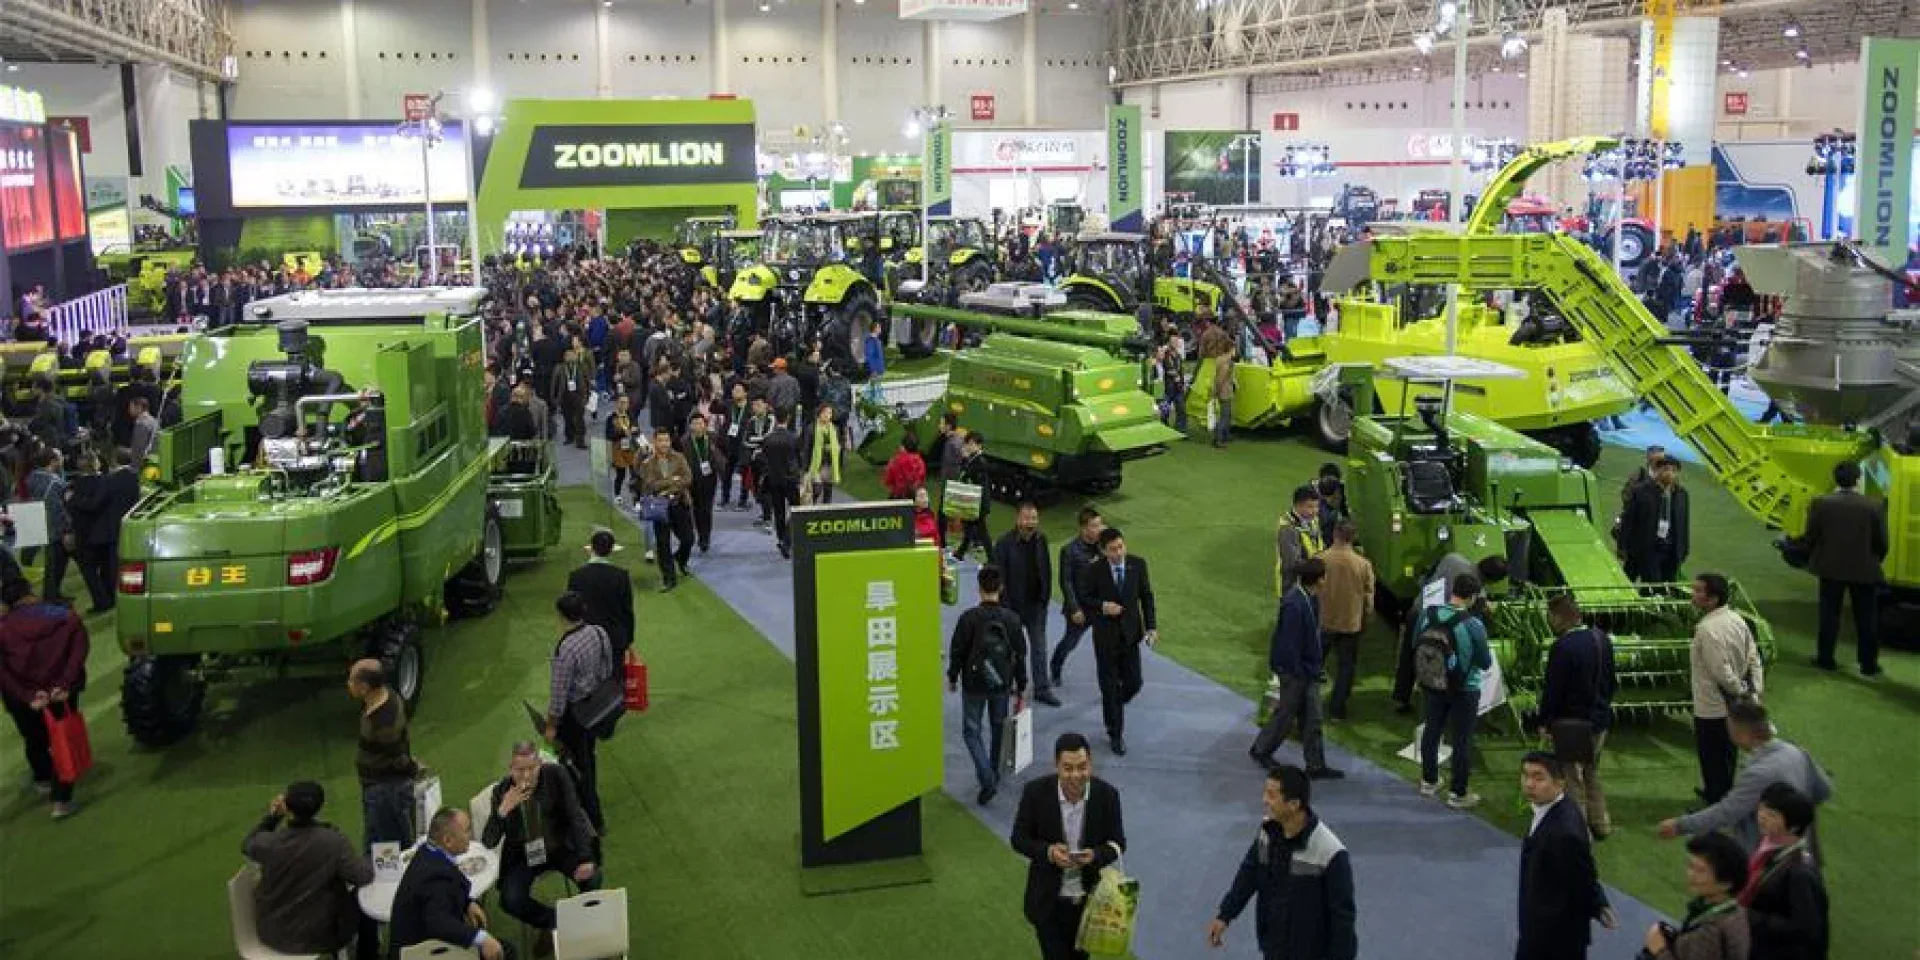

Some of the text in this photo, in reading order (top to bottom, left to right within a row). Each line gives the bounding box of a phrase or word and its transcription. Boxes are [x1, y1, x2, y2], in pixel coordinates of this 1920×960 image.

[554, 142, 724, 168] ZOOMLION
[1118, 118, 1127, 201] ZOOMLION
[1875, 67, 1899, 247] ZOOMLION
[806, 516, 903, 535] ZOOMLION
[865, 580, 900, 750] 旱田展示区
